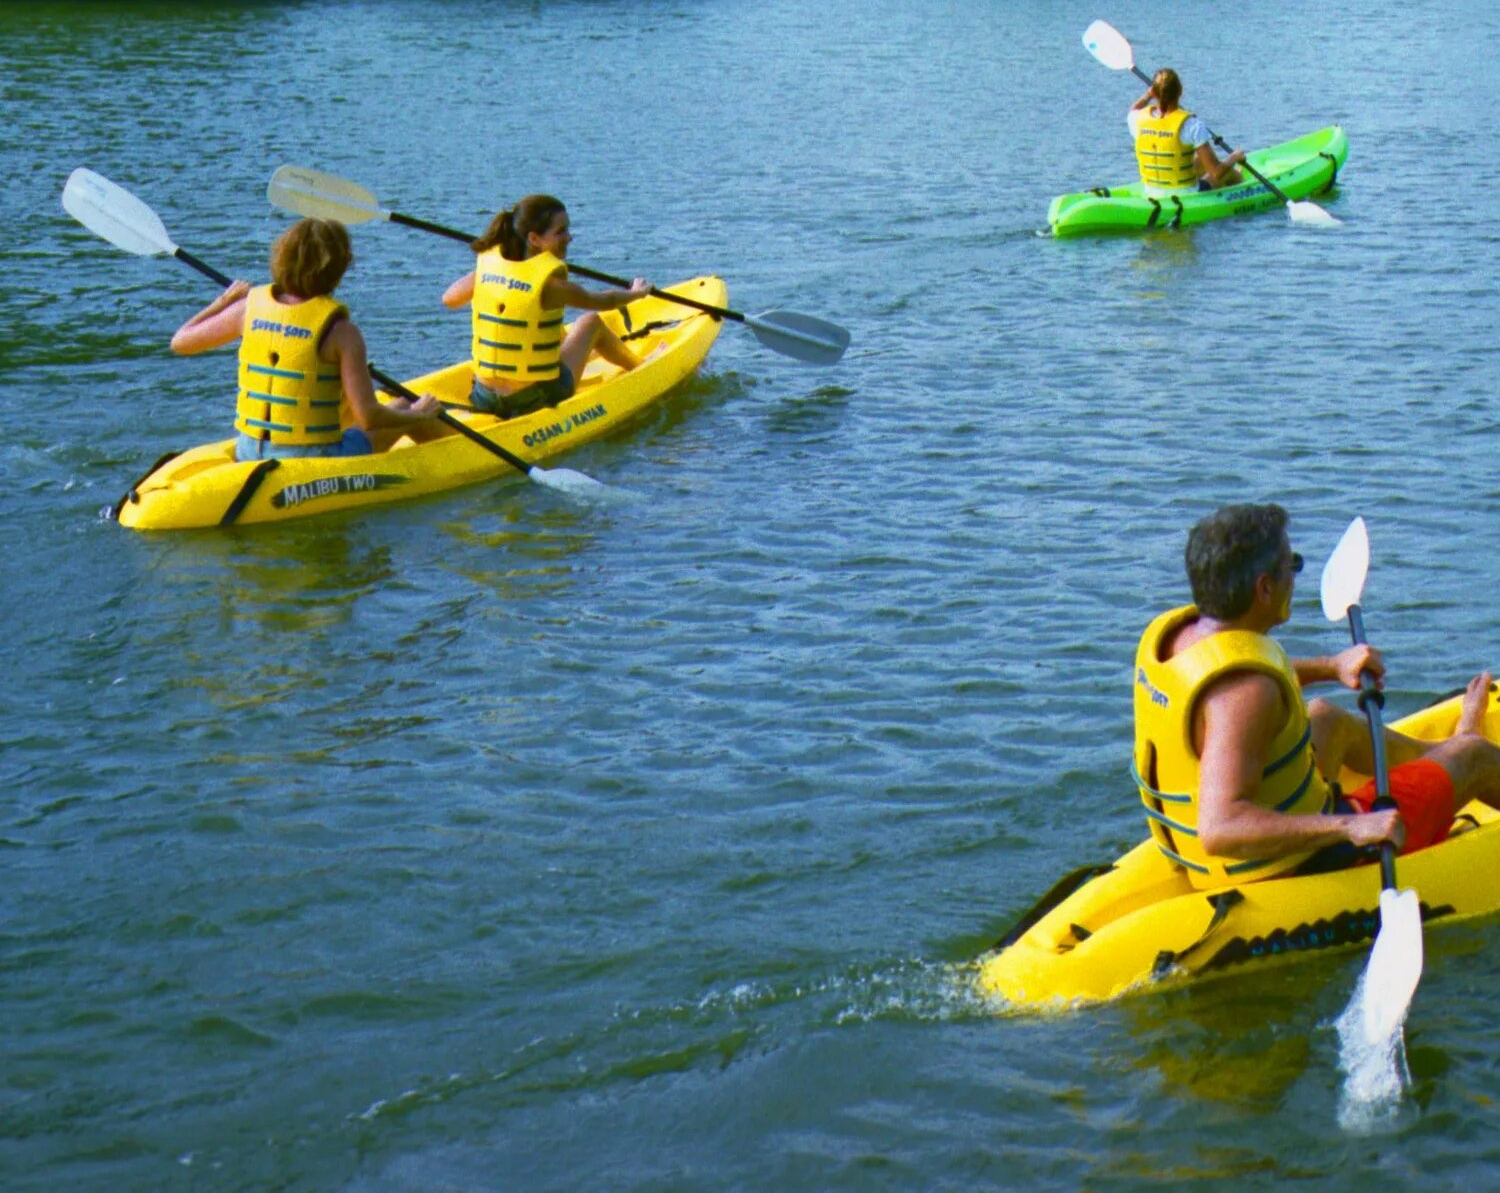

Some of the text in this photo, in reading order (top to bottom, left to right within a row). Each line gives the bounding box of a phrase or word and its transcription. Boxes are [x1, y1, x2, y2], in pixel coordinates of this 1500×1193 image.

[523, 403, 608, 447] OCEAN KAYAK
[283, 474, 375, 507] MALIBU TWO
